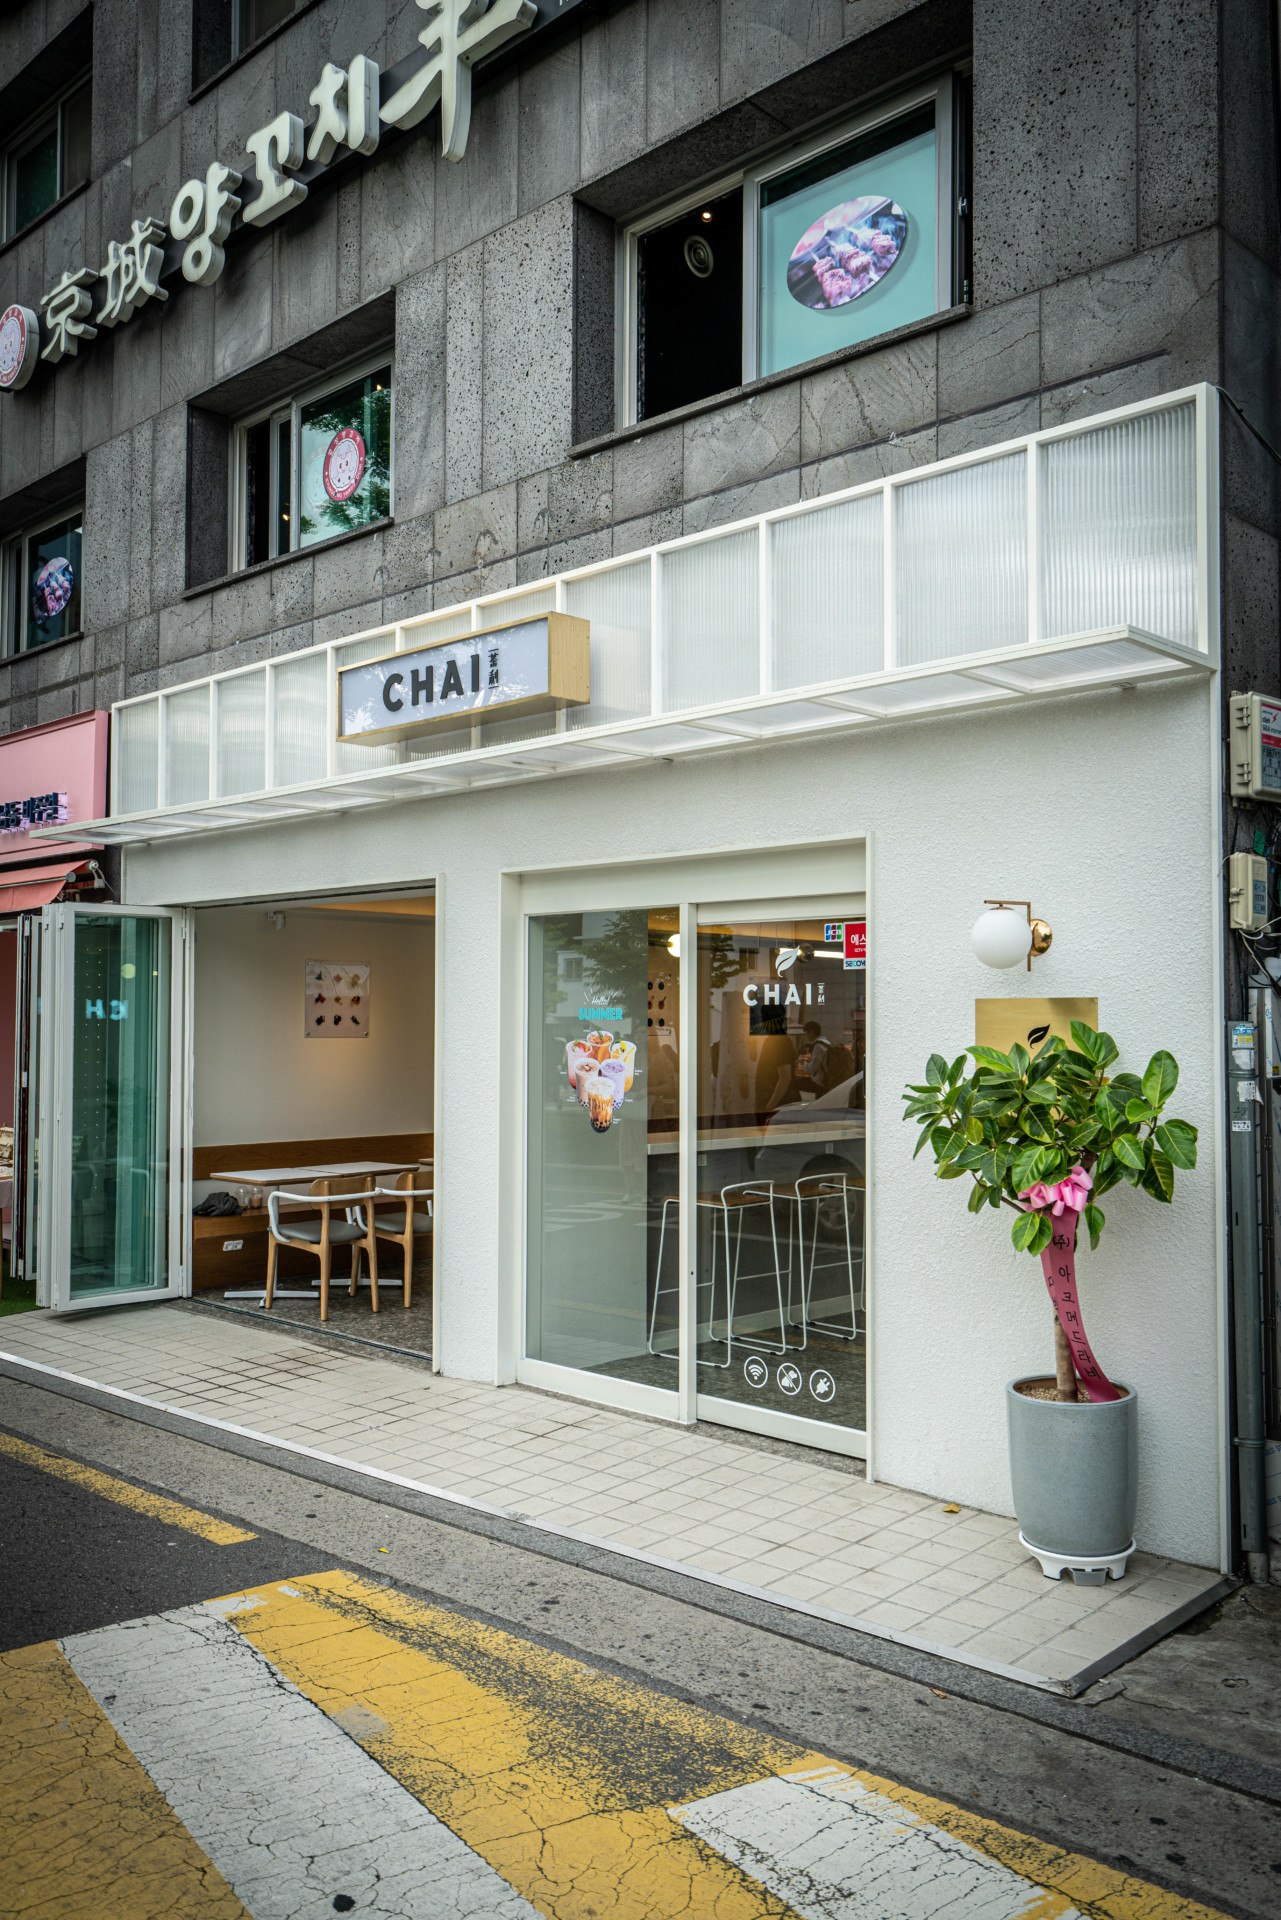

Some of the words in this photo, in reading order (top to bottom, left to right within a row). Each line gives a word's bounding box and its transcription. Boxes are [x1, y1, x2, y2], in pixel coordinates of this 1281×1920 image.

[382, 653, 480, 712] CHAI
[743, 983, 812, 1006] CHAI
[578, 1008, 623, 1020] SUMMER
